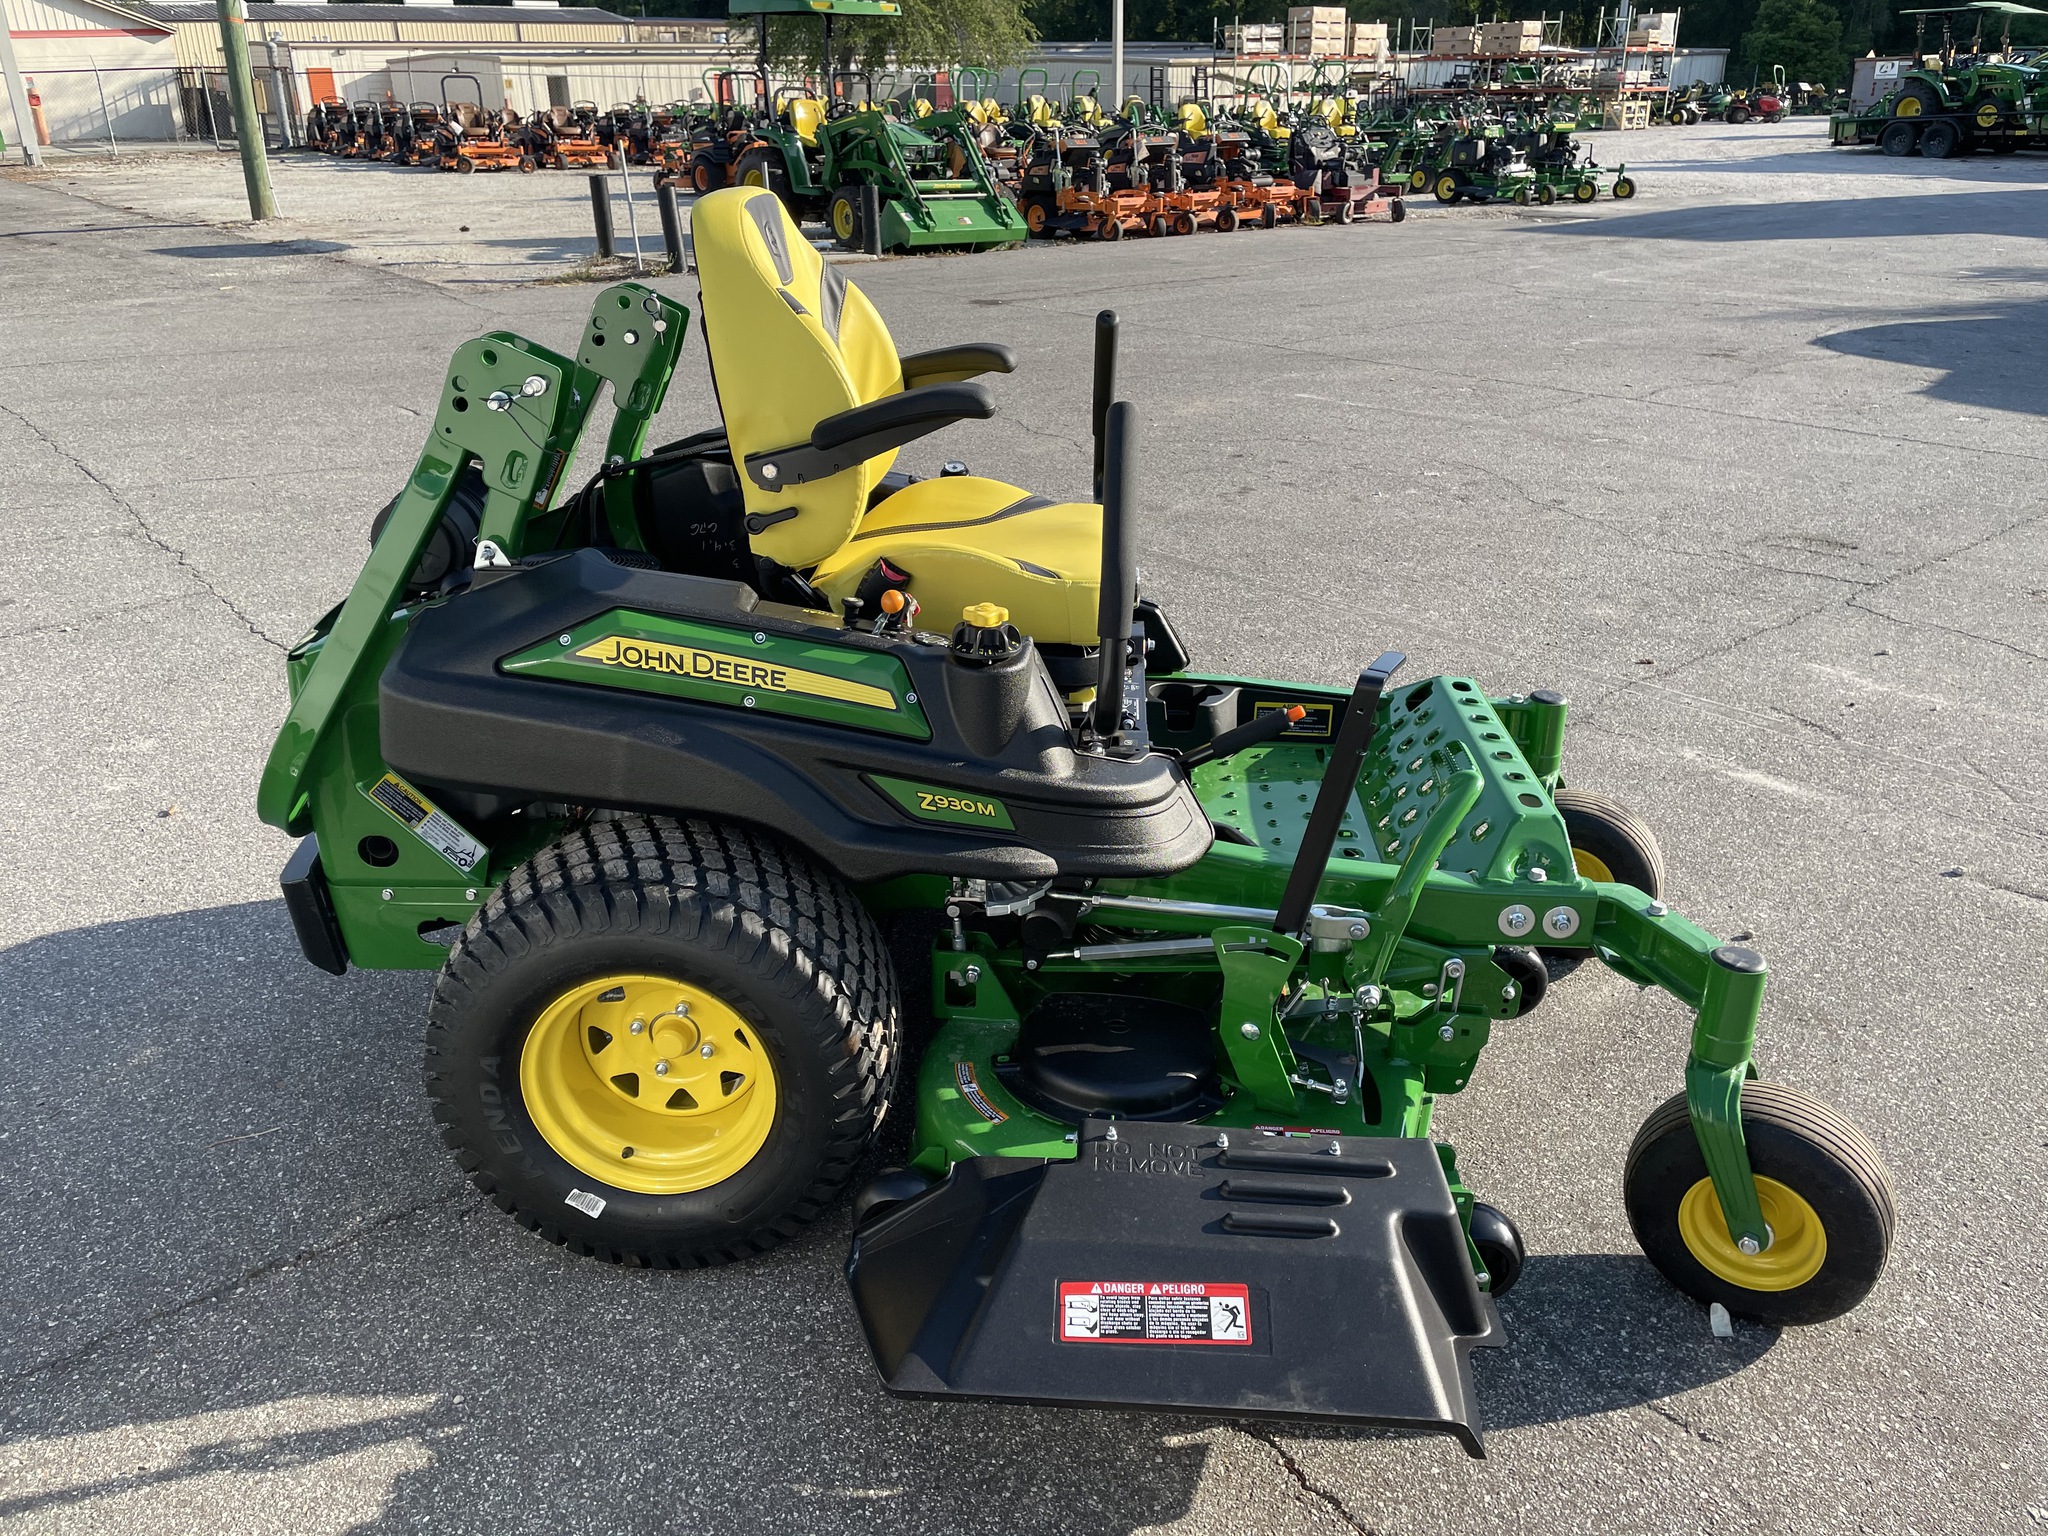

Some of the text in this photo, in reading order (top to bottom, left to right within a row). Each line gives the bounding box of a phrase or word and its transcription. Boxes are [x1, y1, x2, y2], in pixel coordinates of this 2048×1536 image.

[605, 640, 788, 690] JOHN DEERE
[398, 785, 423, 805] CAUTION
[916, 792, 996, 817] Z930M
[480, 1056, 546, 1180] KENDA
[1094, 1141, 1200, 1161] DO NOT
[1094, 1156, 1206, 1178] REMOVE
[1103, 1283, 1206, 1296] DANGER PELIGRO
